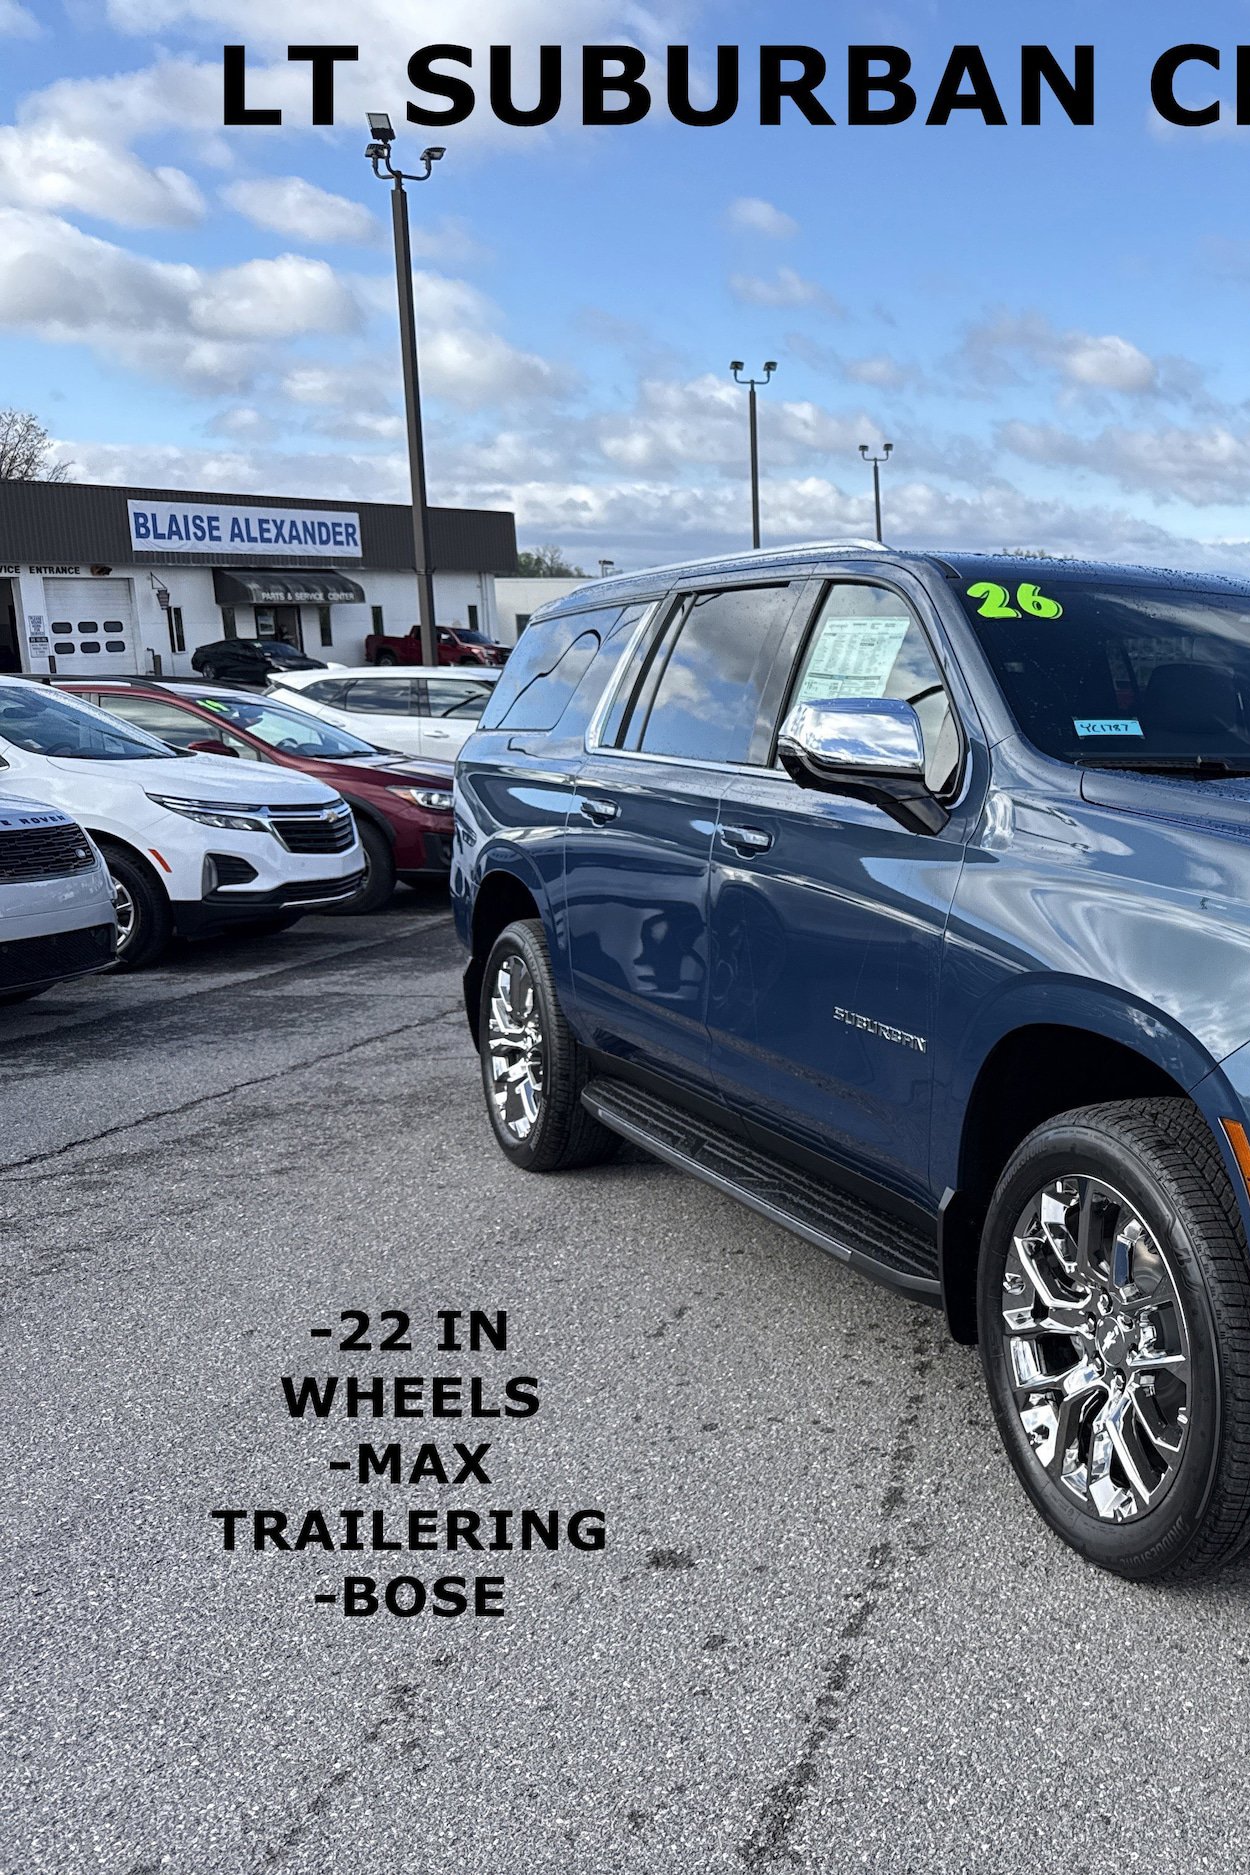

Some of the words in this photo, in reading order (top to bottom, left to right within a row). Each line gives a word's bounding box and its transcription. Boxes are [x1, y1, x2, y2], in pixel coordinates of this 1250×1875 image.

[133, 512, 222, 542] BLAISE
[229, 517, 359, 547] ALEXANDER
[29, 565, 80, 574] ENTRANCE
[261, 592, 285, 601] PARTS
[287, 592, 293, 601] &
[295, 592, 325, 601] SERVICE
[328, 592, 354, 601] CENTER
[966, 582, 1063, 619] 26
[18, 814, 66, 825] ROVER
[833, 1006, 927, 1054] SUBURBAN
